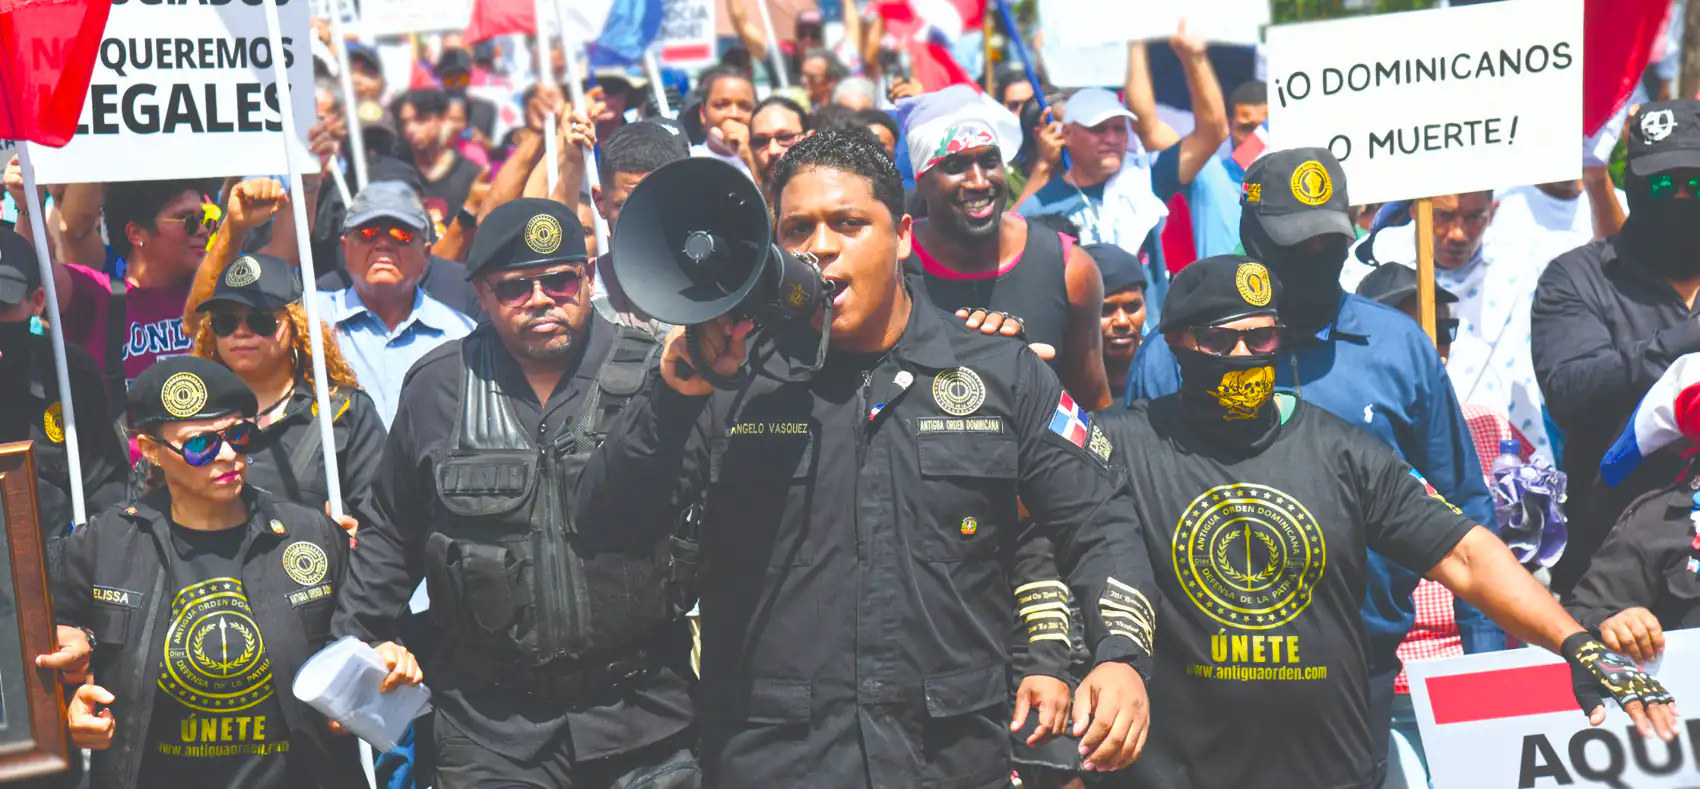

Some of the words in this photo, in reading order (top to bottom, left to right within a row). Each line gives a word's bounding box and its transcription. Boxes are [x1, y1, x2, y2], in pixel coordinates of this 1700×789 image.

[100, 37, 294, 76] QUEREMOS
[1322, 41, 1574, 96] DOMINICANOS
[1328, 134, 1352, 162] O
[122, 316, 192, 361] OND
[730, 423, 765, 435] ANGELO
[768, 423, 808, 434] VASQUEZ
[1197, 514, 1220, 551] ANTIGUA
[1222, 505, 1255, 516] ORDEN
[1257, 507, 1300, 555] DOMINICANA
[1202, 567, 1235, 600] DEFENSA
[1240, 595, 1252, 604] DE
[1257, 595, 1269, 604] LA
[173, 609, 198, 644] ANTIGUA
[198, 599, 229, 611] ORDEN
[1211, 628, 1300, 663] ÚNETE
[176, 660, 209, 688] DEFENSA
[181, 713, 266, 743] ÚNETE
